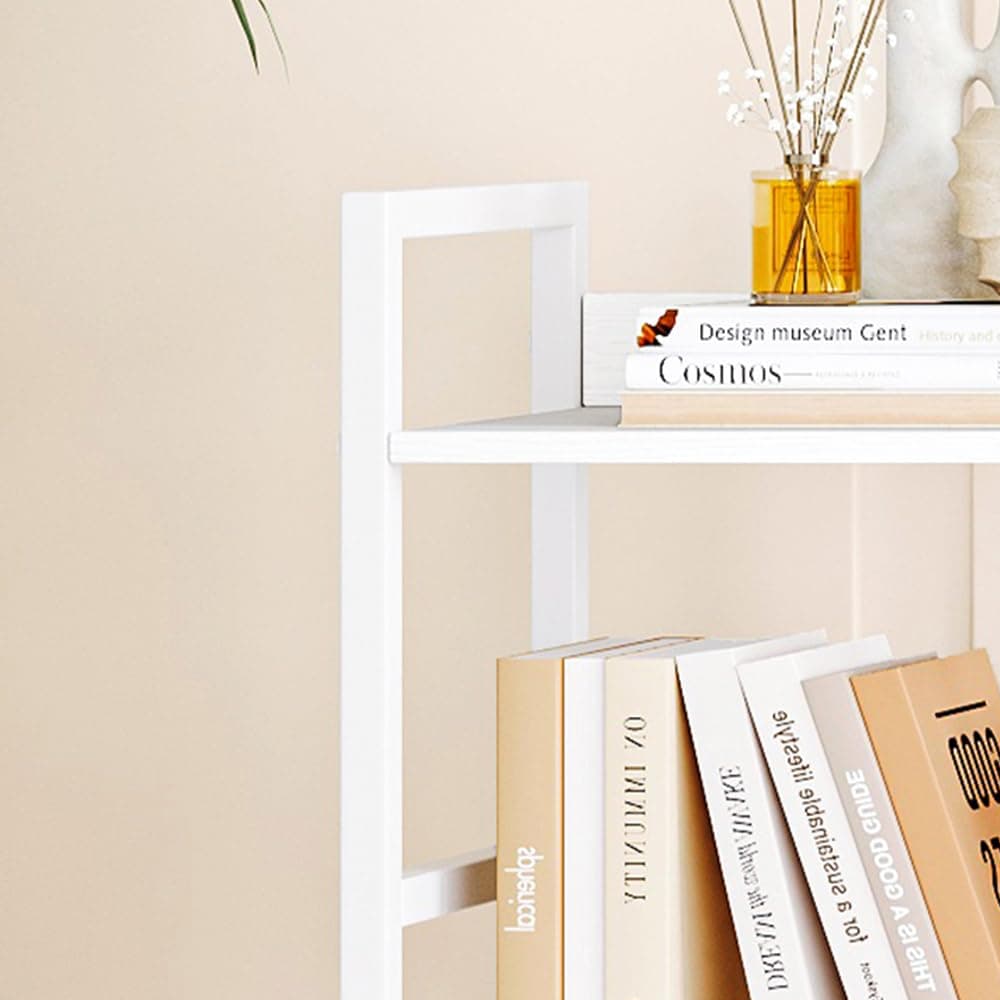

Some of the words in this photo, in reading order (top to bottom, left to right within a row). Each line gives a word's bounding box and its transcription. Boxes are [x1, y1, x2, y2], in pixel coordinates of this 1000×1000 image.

[699, 323, 765, 346] Design
[771, 327, 853, 341] museum
[860, 323, 908, 341] Gent
[919, 329, 964, 344] History
[971, 329, 994, 343] and
[658, 354, 783, 386] Cosmos
